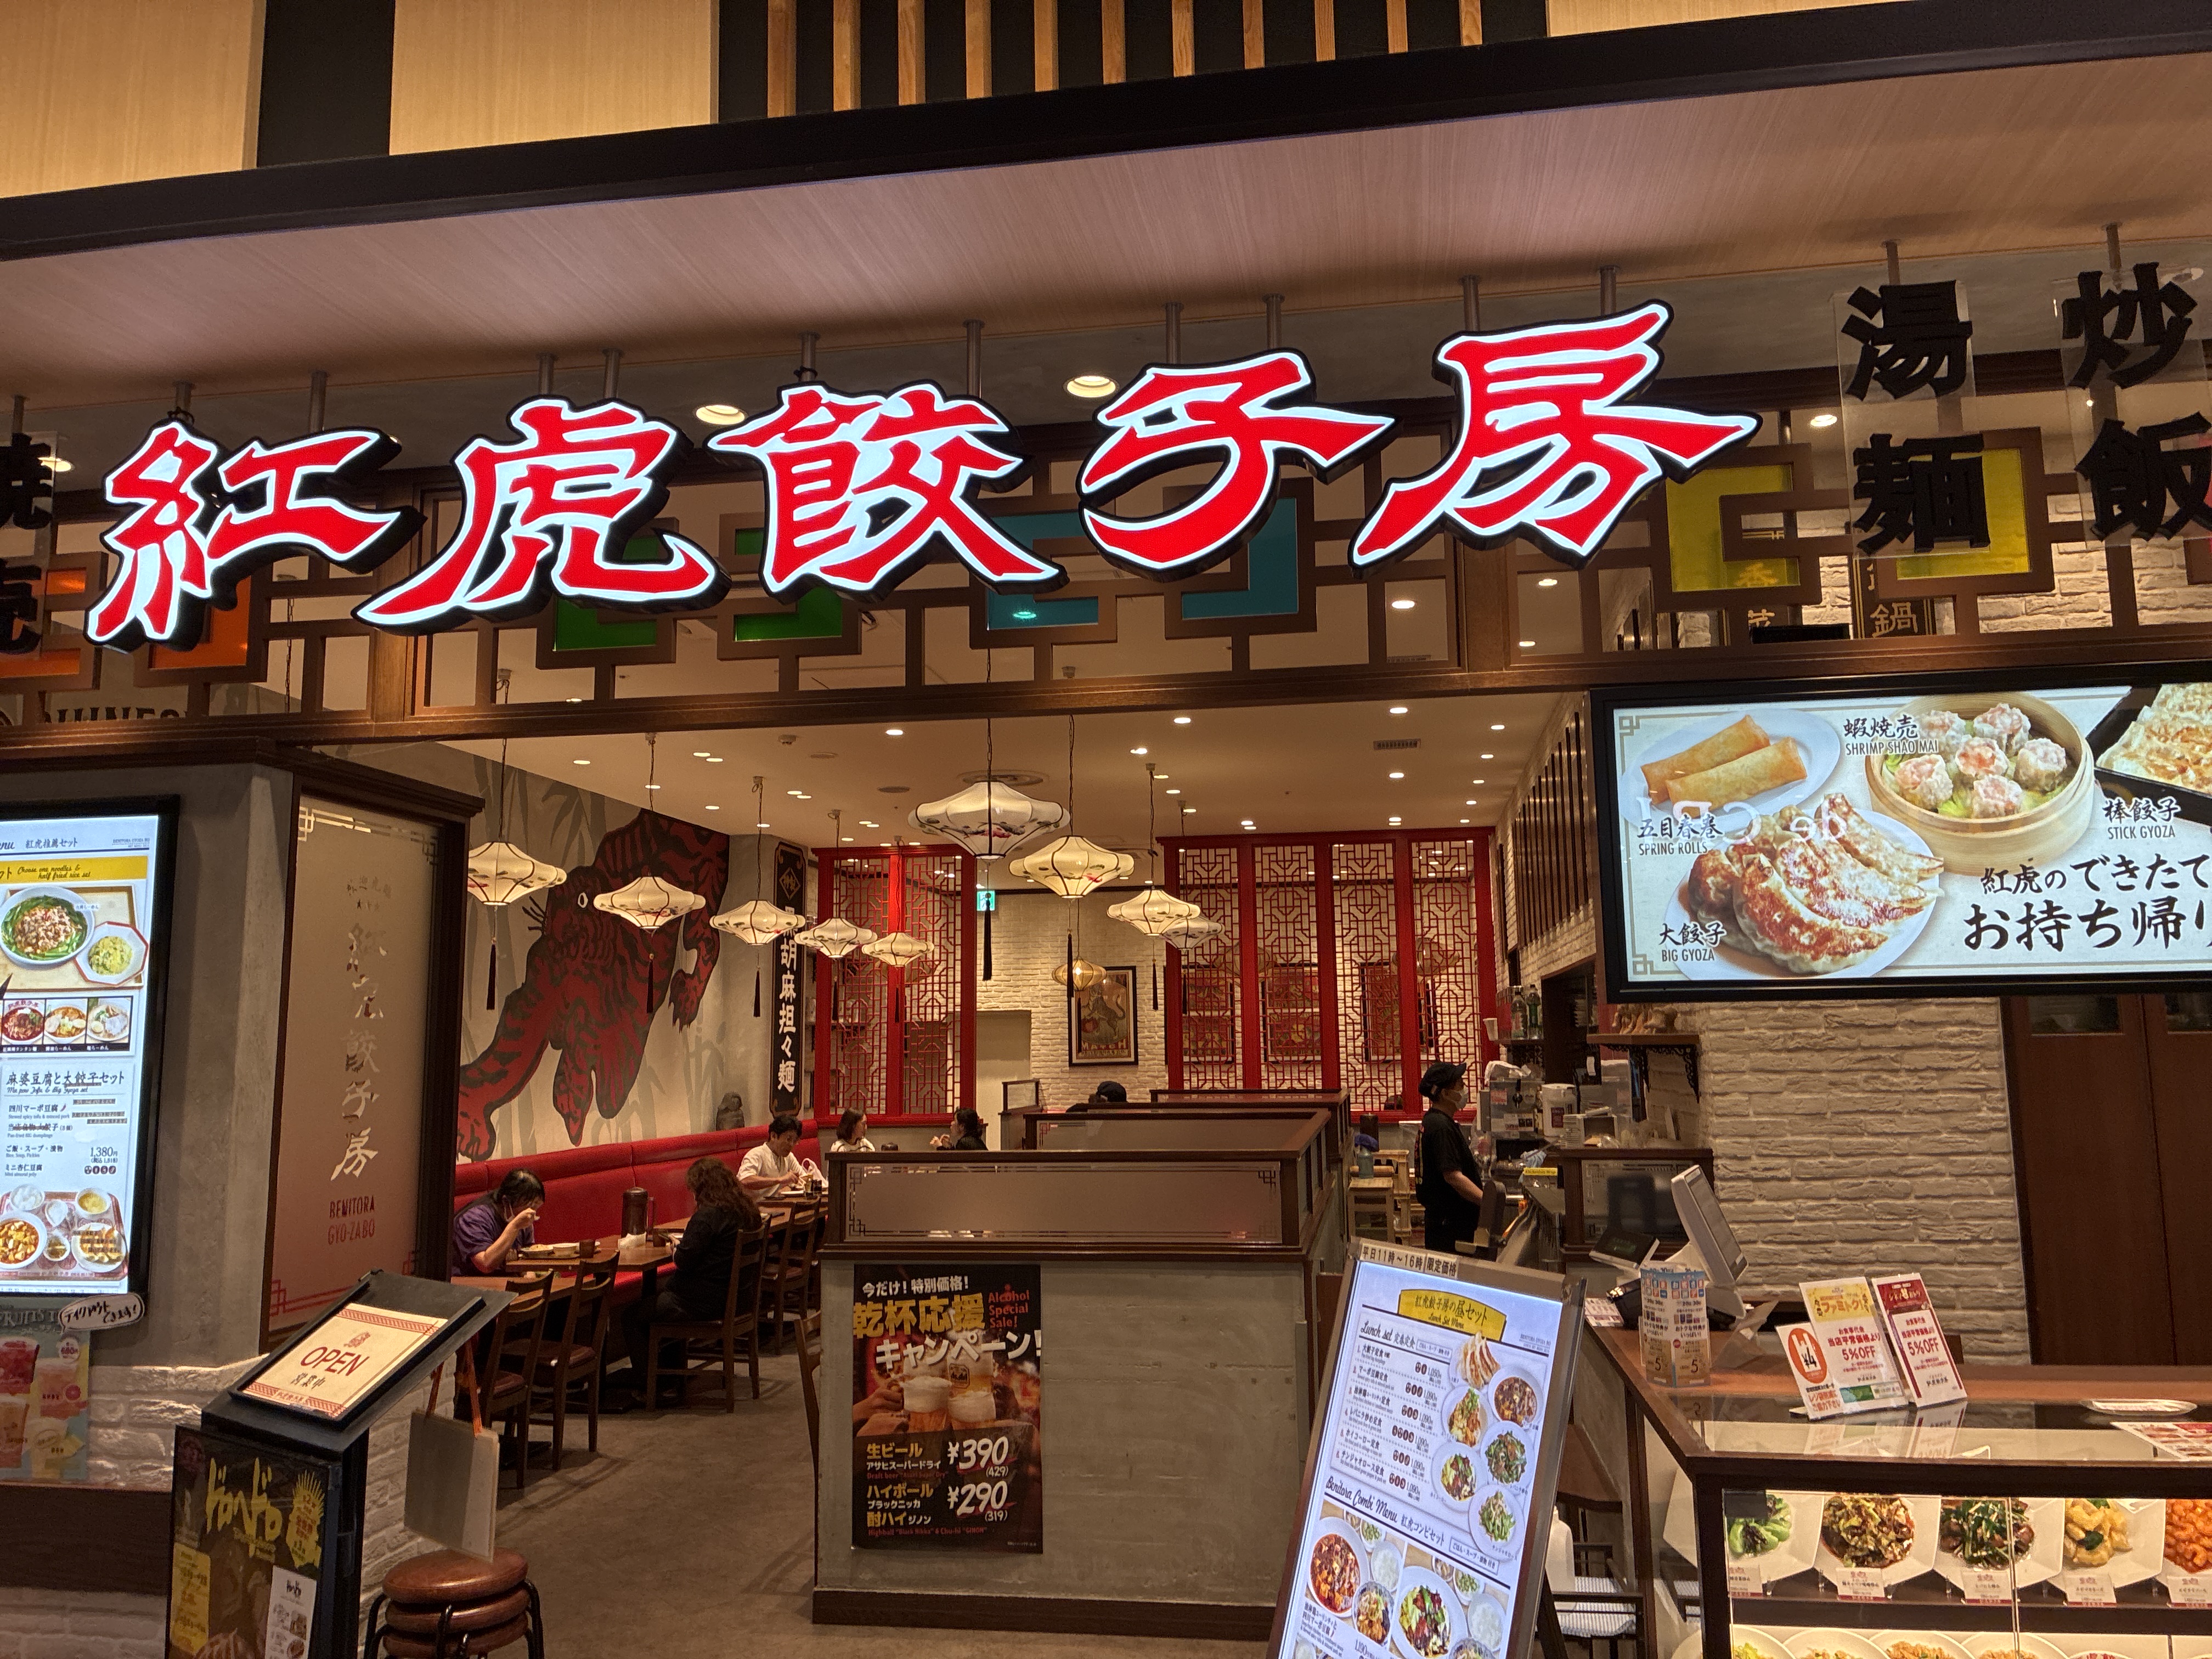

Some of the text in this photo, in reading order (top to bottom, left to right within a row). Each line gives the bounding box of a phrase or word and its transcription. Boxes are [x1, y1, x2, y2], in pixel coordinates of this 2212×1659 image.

[2062, 262, 2212, 541] 炒飯
[86, 301, 1760, 648] 紅虎餃子房
[1843, 714, 1918, 739] 蝦焼売
[1846, 738, 1938, 755] SHRIMP SHAO MAI
[2102, 797, 2181, 823] 棒餃子
[1637, 814, 1723, 839] 五目春巻
[2108, 825, 2176, 839] STICK GYOZA
[1639, 841, 1708, 856] SPRING ROLLS
[18, 866, 37, 874] Choose
[52, 872, 67, 881] fried
[1980, 853, 2210, 895] 紅虎のできたて
[1659, 922, 1726, 946] 大餃子
[1662, 947, 1715, 962] BIG GYOZA
[6, 1071, 124, 1086] 麻婆豆腐と大餃子セット
[90, 1147, 118, 1158] 1,380円
[330, 1195, 375, 1219] BENITORA
[328, 1218, 375, 1245] GYO-ZABO
[1426, 1257, 1457, 1277] 限定価格
[988, 1290, 1030, 1304] Alcohol
[854, 1293, 985, 1339] 乾杯応援
[989, 1303, 1029, 1316] Special
[990, 1316, 1018, 1328] Sale!
[1361, 1321, 1393, 1341] Lunch set
[876, 1329, 1041, 1370] キャンペーン!
[1842, 1346, 1876, 1361] 5%OFF
[1907, 1337, 1939, 1356] 5%OFF
[301, 1346, 370, 1376] OPEN
[290, 1372, 326, 1390] 営業中
[866, 1436, 1009, 1470] 生ビール ¥390
[866, 1460, 1009, 1477] アサヒスーパードライ (429)
[867, 1481, 1008, 1516] ハイボール ¥290
[1325, 1476, 1398, 1523] Benitora Combi Menu
[867, 1498, 1008, 1523] ブラックニッカ (319)
[867, 1511, 907, 1527] 酎ハイ
